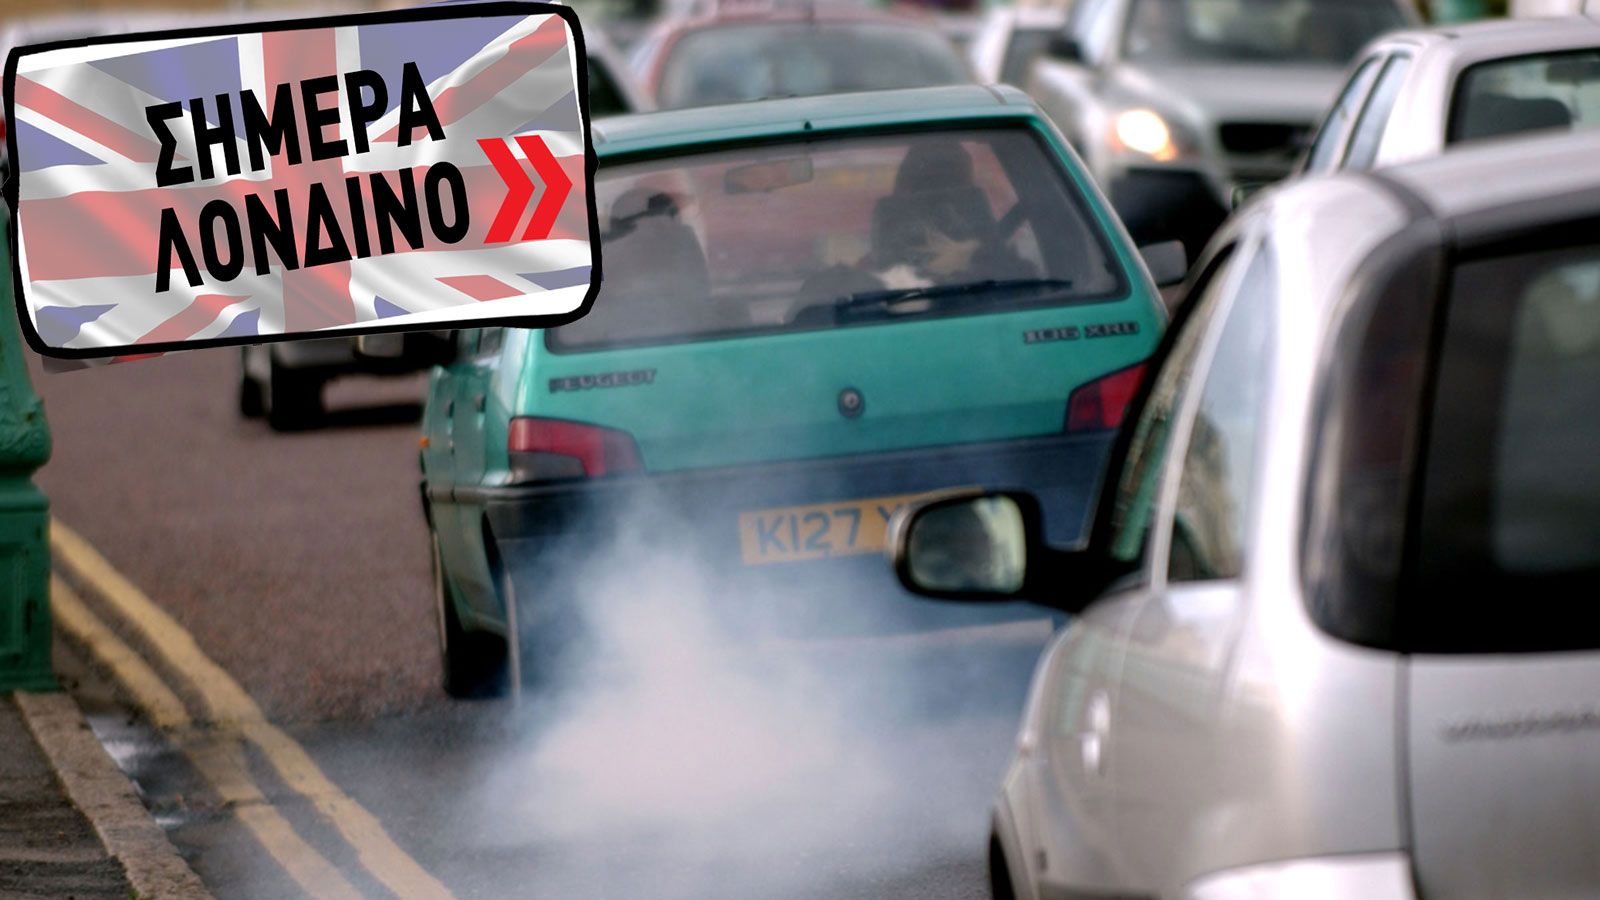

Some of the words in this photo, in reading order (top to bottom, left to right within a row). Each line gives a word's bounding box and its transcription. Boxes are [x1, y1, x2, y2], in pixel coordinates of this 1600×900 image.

[1024, 326, 1080, 344] 106
[549, 368, 657, 394] PEUGEOT
[756, 507, 863, 556] K127
